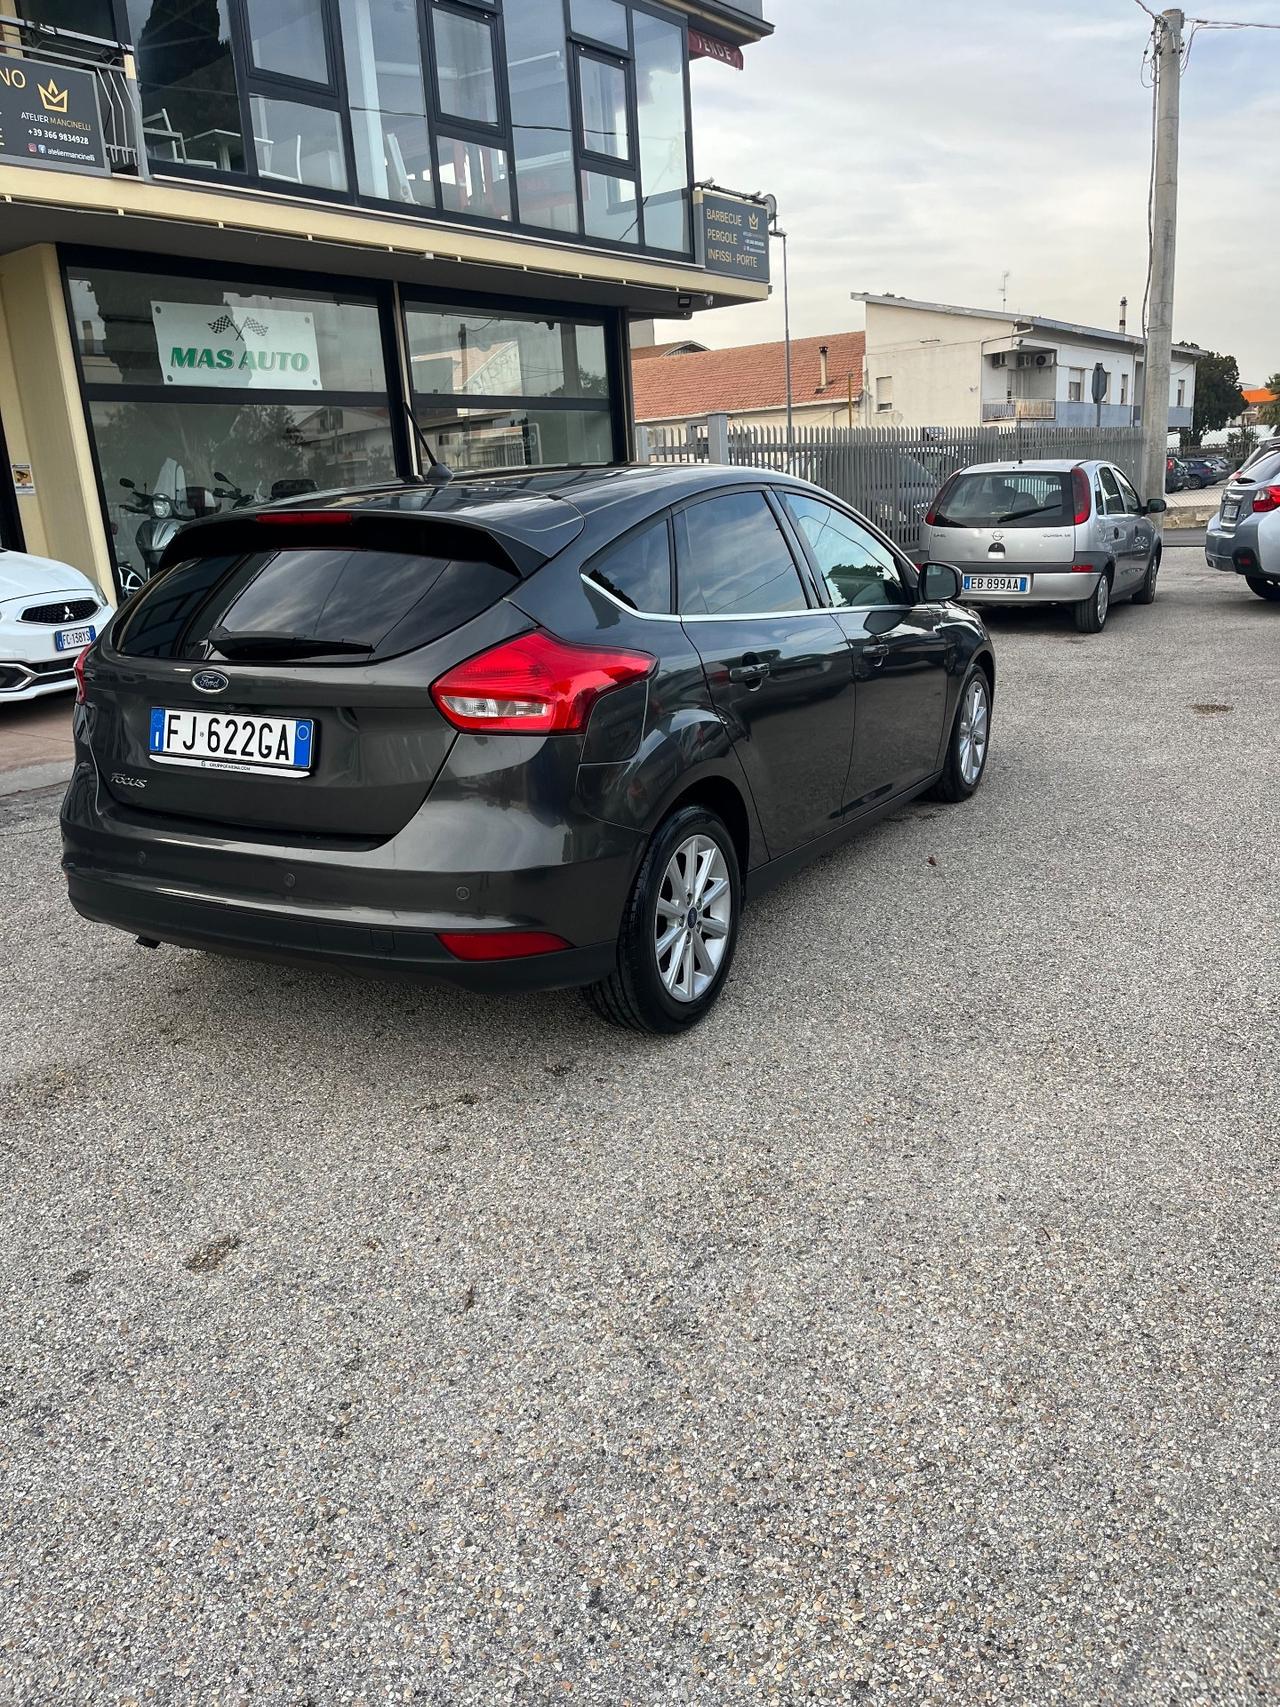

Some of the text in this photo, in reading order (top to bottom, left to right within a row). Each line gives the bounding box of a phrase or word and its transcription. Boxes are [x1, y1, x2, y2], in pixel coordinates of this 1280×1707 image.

[697, 35, 732, 61] TENDE
[20, 111, 91, 130] ATELIER MANCINELLI
[28, 128, 89, 145] +39 366 9834928
[47, 148, 95, 161] ateliermancinelli
[706, 208, 742, 226] BARBECUE
[707, 228, 738, 245] PERGOLE
[707, 248, 732, 262] INFISSI
[736, 254, 758, 268] PORTE
[170, 347, 310, 371] MAS AUTO
